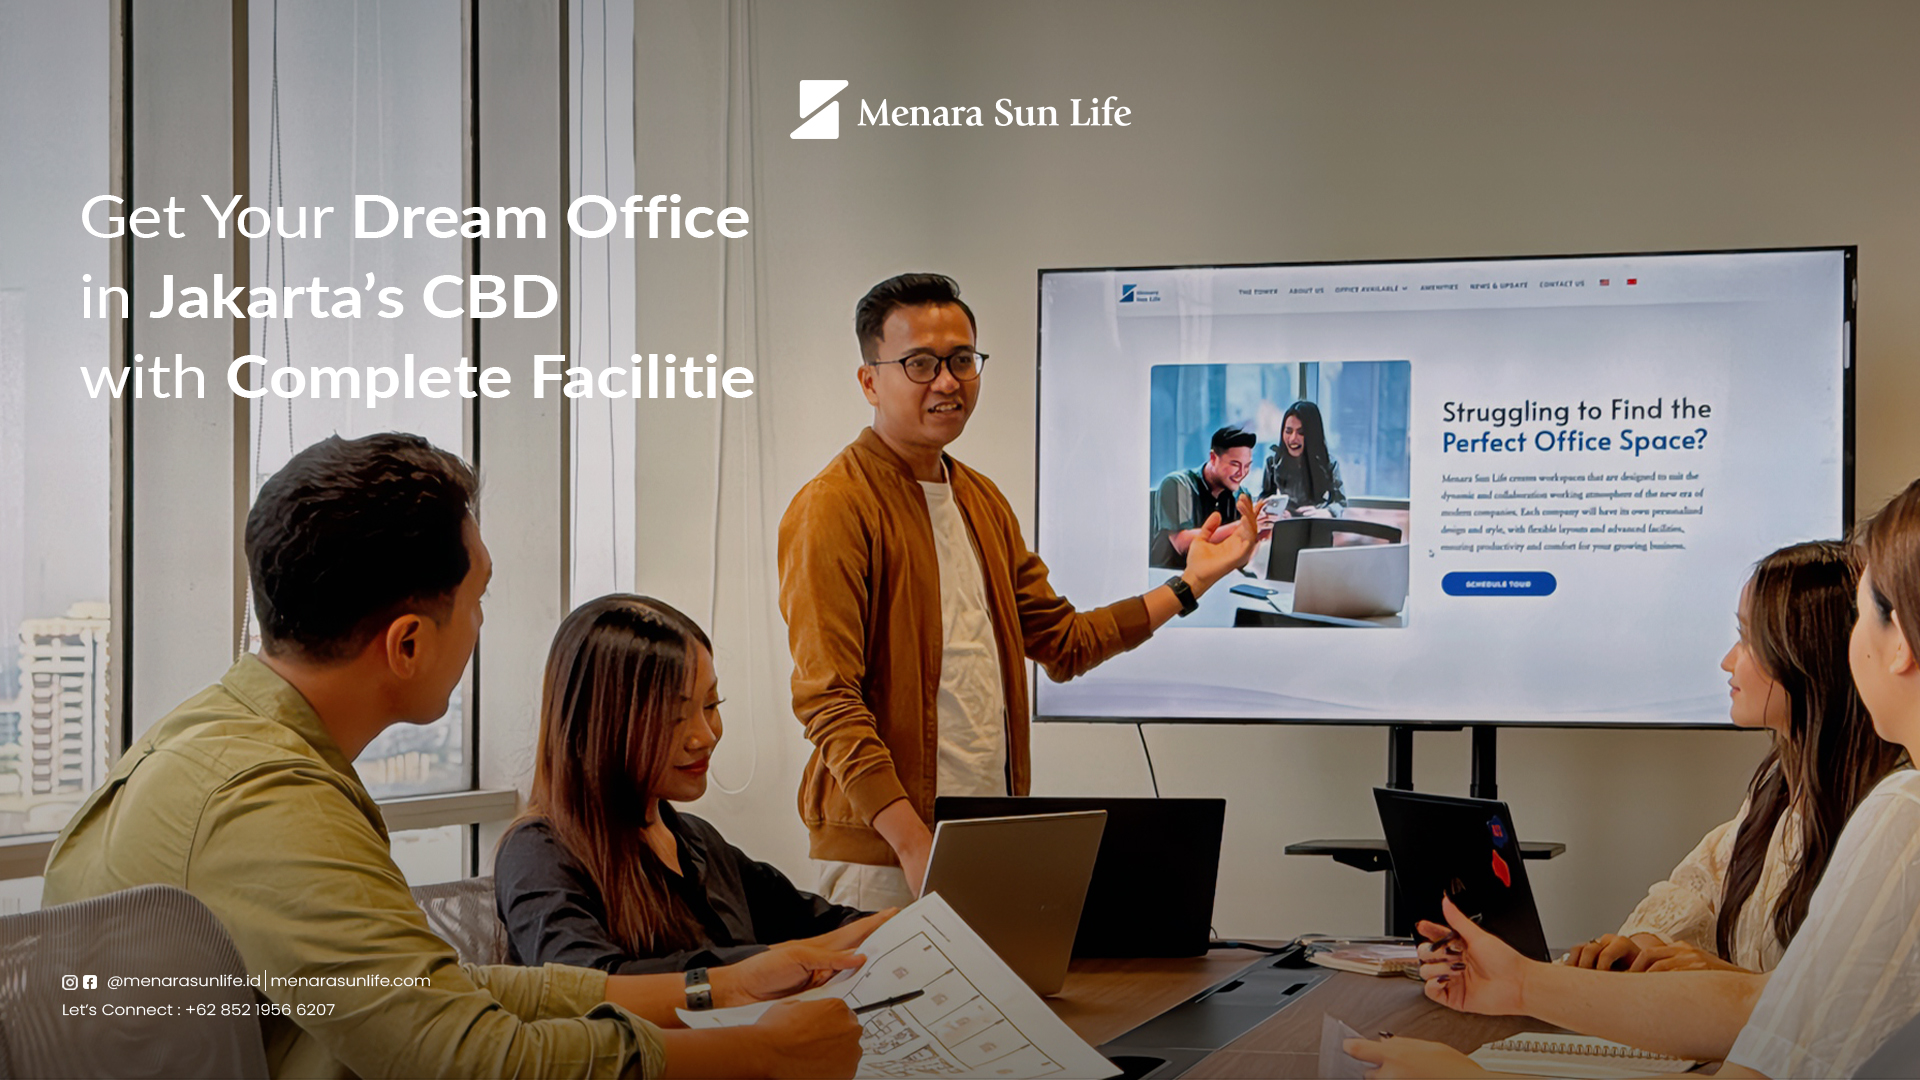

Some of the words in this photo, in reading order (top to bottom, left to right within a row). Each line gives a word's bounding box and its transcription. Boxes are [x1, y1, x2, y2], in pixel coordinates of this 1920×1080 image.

[1443, 400, 1569, 427] Struggling
[1578, 401, 1602, 421] to
[1611, 398, 1662, 420] Find
[1671, 397, 1711, 419] the
[1443, 431, 1527, 453] Perfect
[1535, 430, 1611, 452] Office
[1620, 428, 1708, 457] Space?
[1442, 474, 1472, 482] Menara
[1492, 473, 1507, 482] Life
[1539, 472, 1585, 484] workspaces
[1621, 472, 1655, 483] designed
[1686, 471, 1699, 480] the
[1441, 491, 1474, 502] dynamic
[1477, 491, 1492, 499] and
[1550, 490, 1583, 500] working
[1634, 489, 1643, 497] of
[1646, 489, 1658, 497] the
[1695, 488, 1704, 497] of
[1441, 508, 1471, 516] modern
[1521, 507, 1540, 516] Each
[1542, 509, 1579, 517] company
[1582, 507, 1596, 515] will
[1599, 506, 1617, 515] have
[1441, 525, 1466, 535] design
[1468, 525, 1483, 533] and
[1508, 525, 1525, 533] with
[1528, 525, 1556, 533] flexible
[1559, 524, 1588, 535] layouts
[1590, 524, 1605, 533] and
[1608, 524, 1646, 533] advanced
[1477, 542, 1524, 552] productivity
[1527, 542, 1541, 550] and
[1544, 541, 1576, 550] comfort
[1579, 541, 1590, 550] for
[1593, 544, 1611, 552] your
[1614, 542, 1647, 552] growing
[1466, 580, 1507, 588] SCHEDULE
